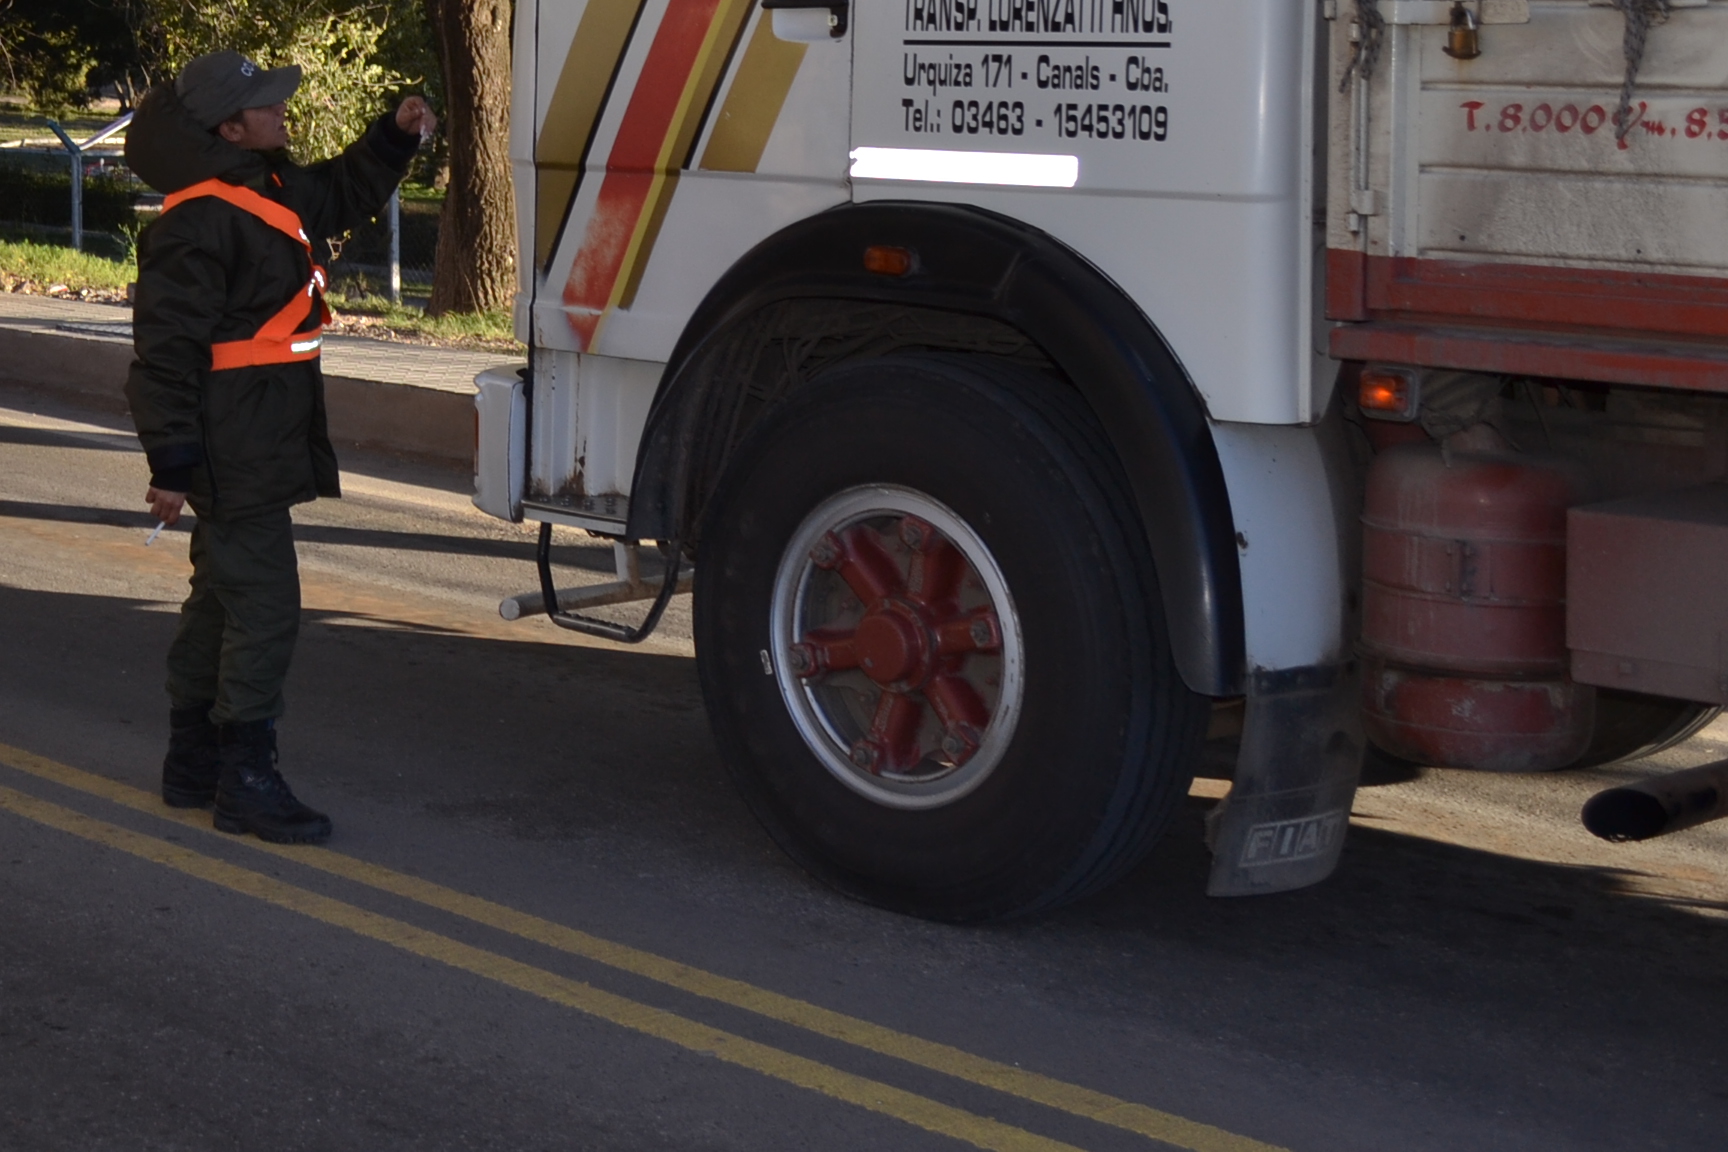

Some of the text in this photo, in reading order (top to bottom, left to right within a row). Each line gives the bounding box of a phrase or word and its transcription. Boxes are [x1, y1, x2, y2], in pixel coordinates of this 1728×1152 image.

[903, 52, 973, 97] Urquiza
[980, 53, 1013, 88] 171
[1036, 54, 1100, 90] Canals
[1125, 55, 1169, 93] Cba.
[901, 98, 941, 133] Tel.:
[951, 100, 1025, 135] 03463
[1053, 102, 1169, 142] 15453109
[1247, 816, 1343, 860] FIAT
